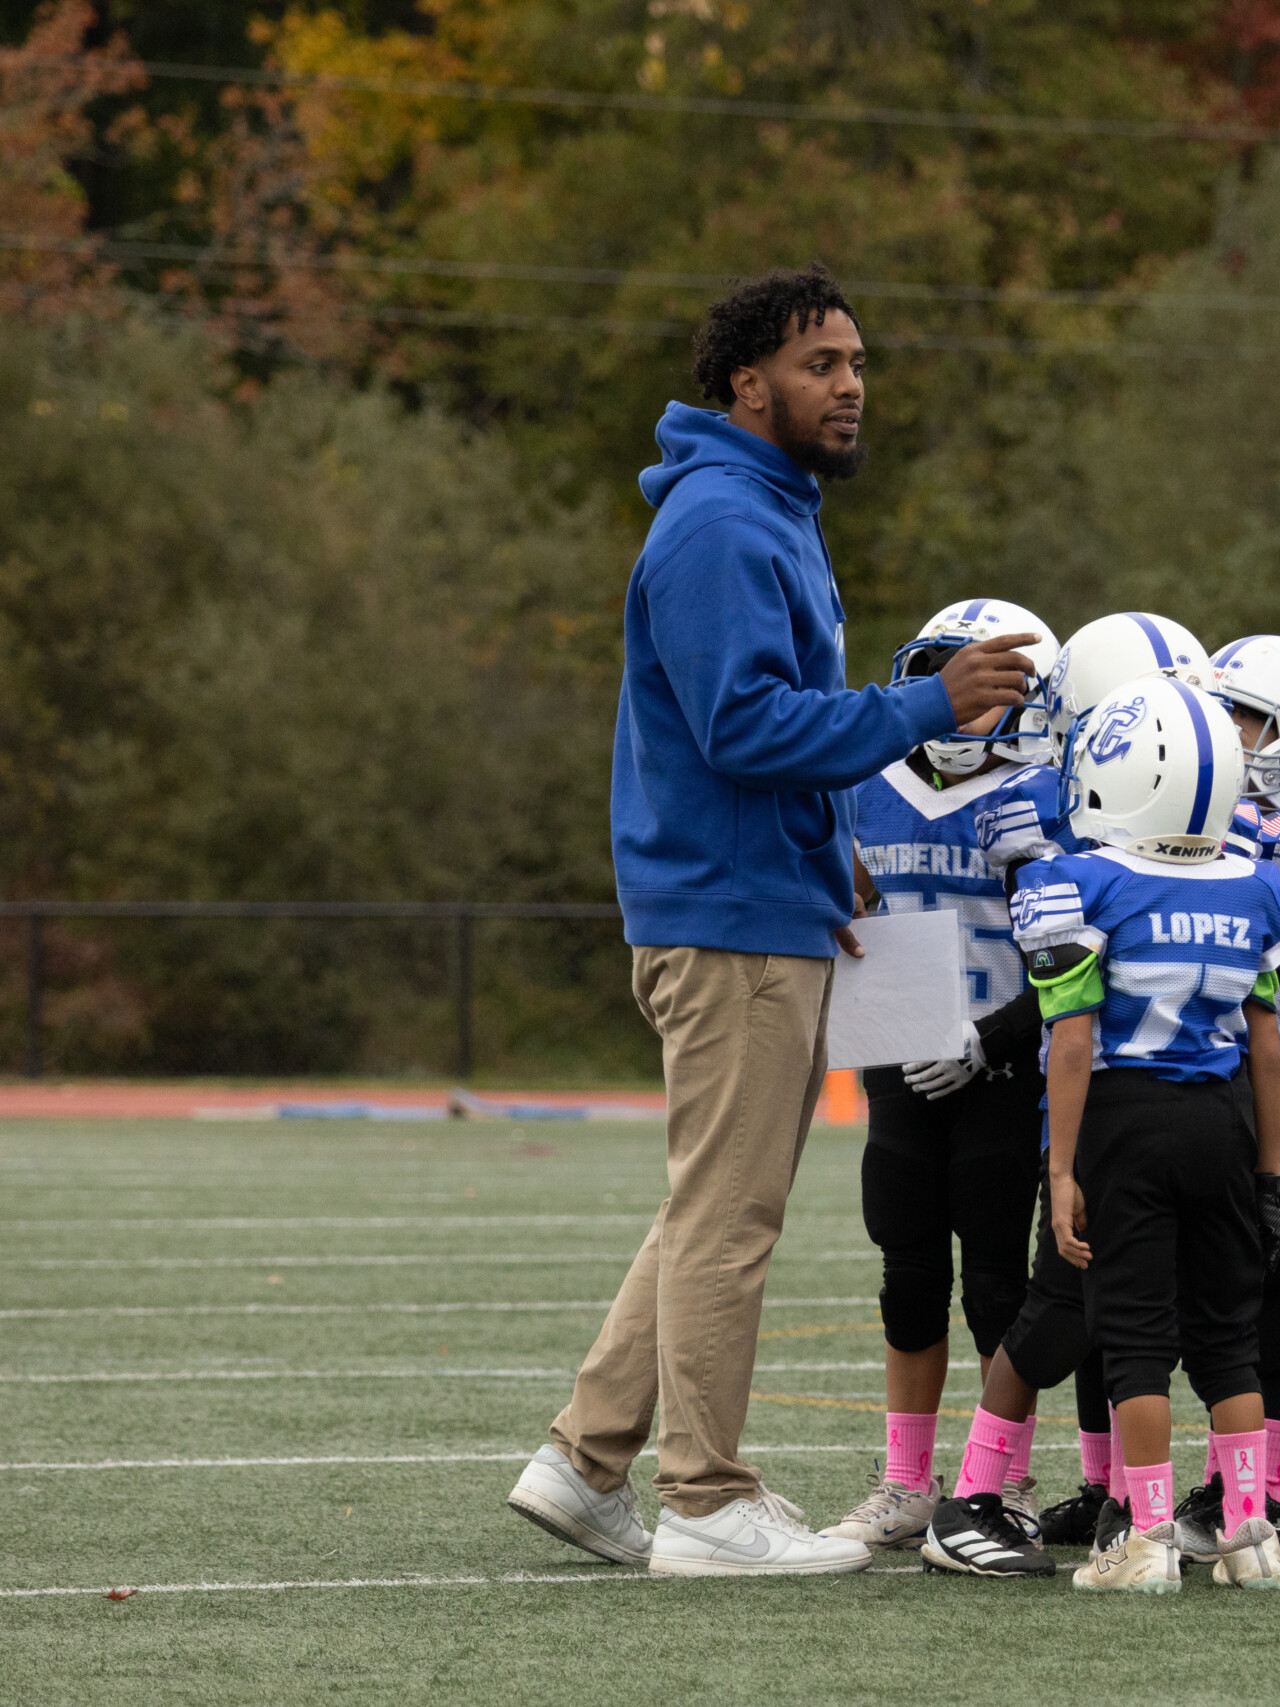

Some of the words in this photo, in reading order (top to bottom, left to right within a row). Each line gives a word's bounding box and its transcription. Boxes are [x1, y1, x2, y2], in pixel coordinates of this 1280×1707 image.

[1154, 842, 1216, 858] XENITH
[1149, 911, 1251, 950] LOPEZ
[1107, 961, 1260, 1060] 77
